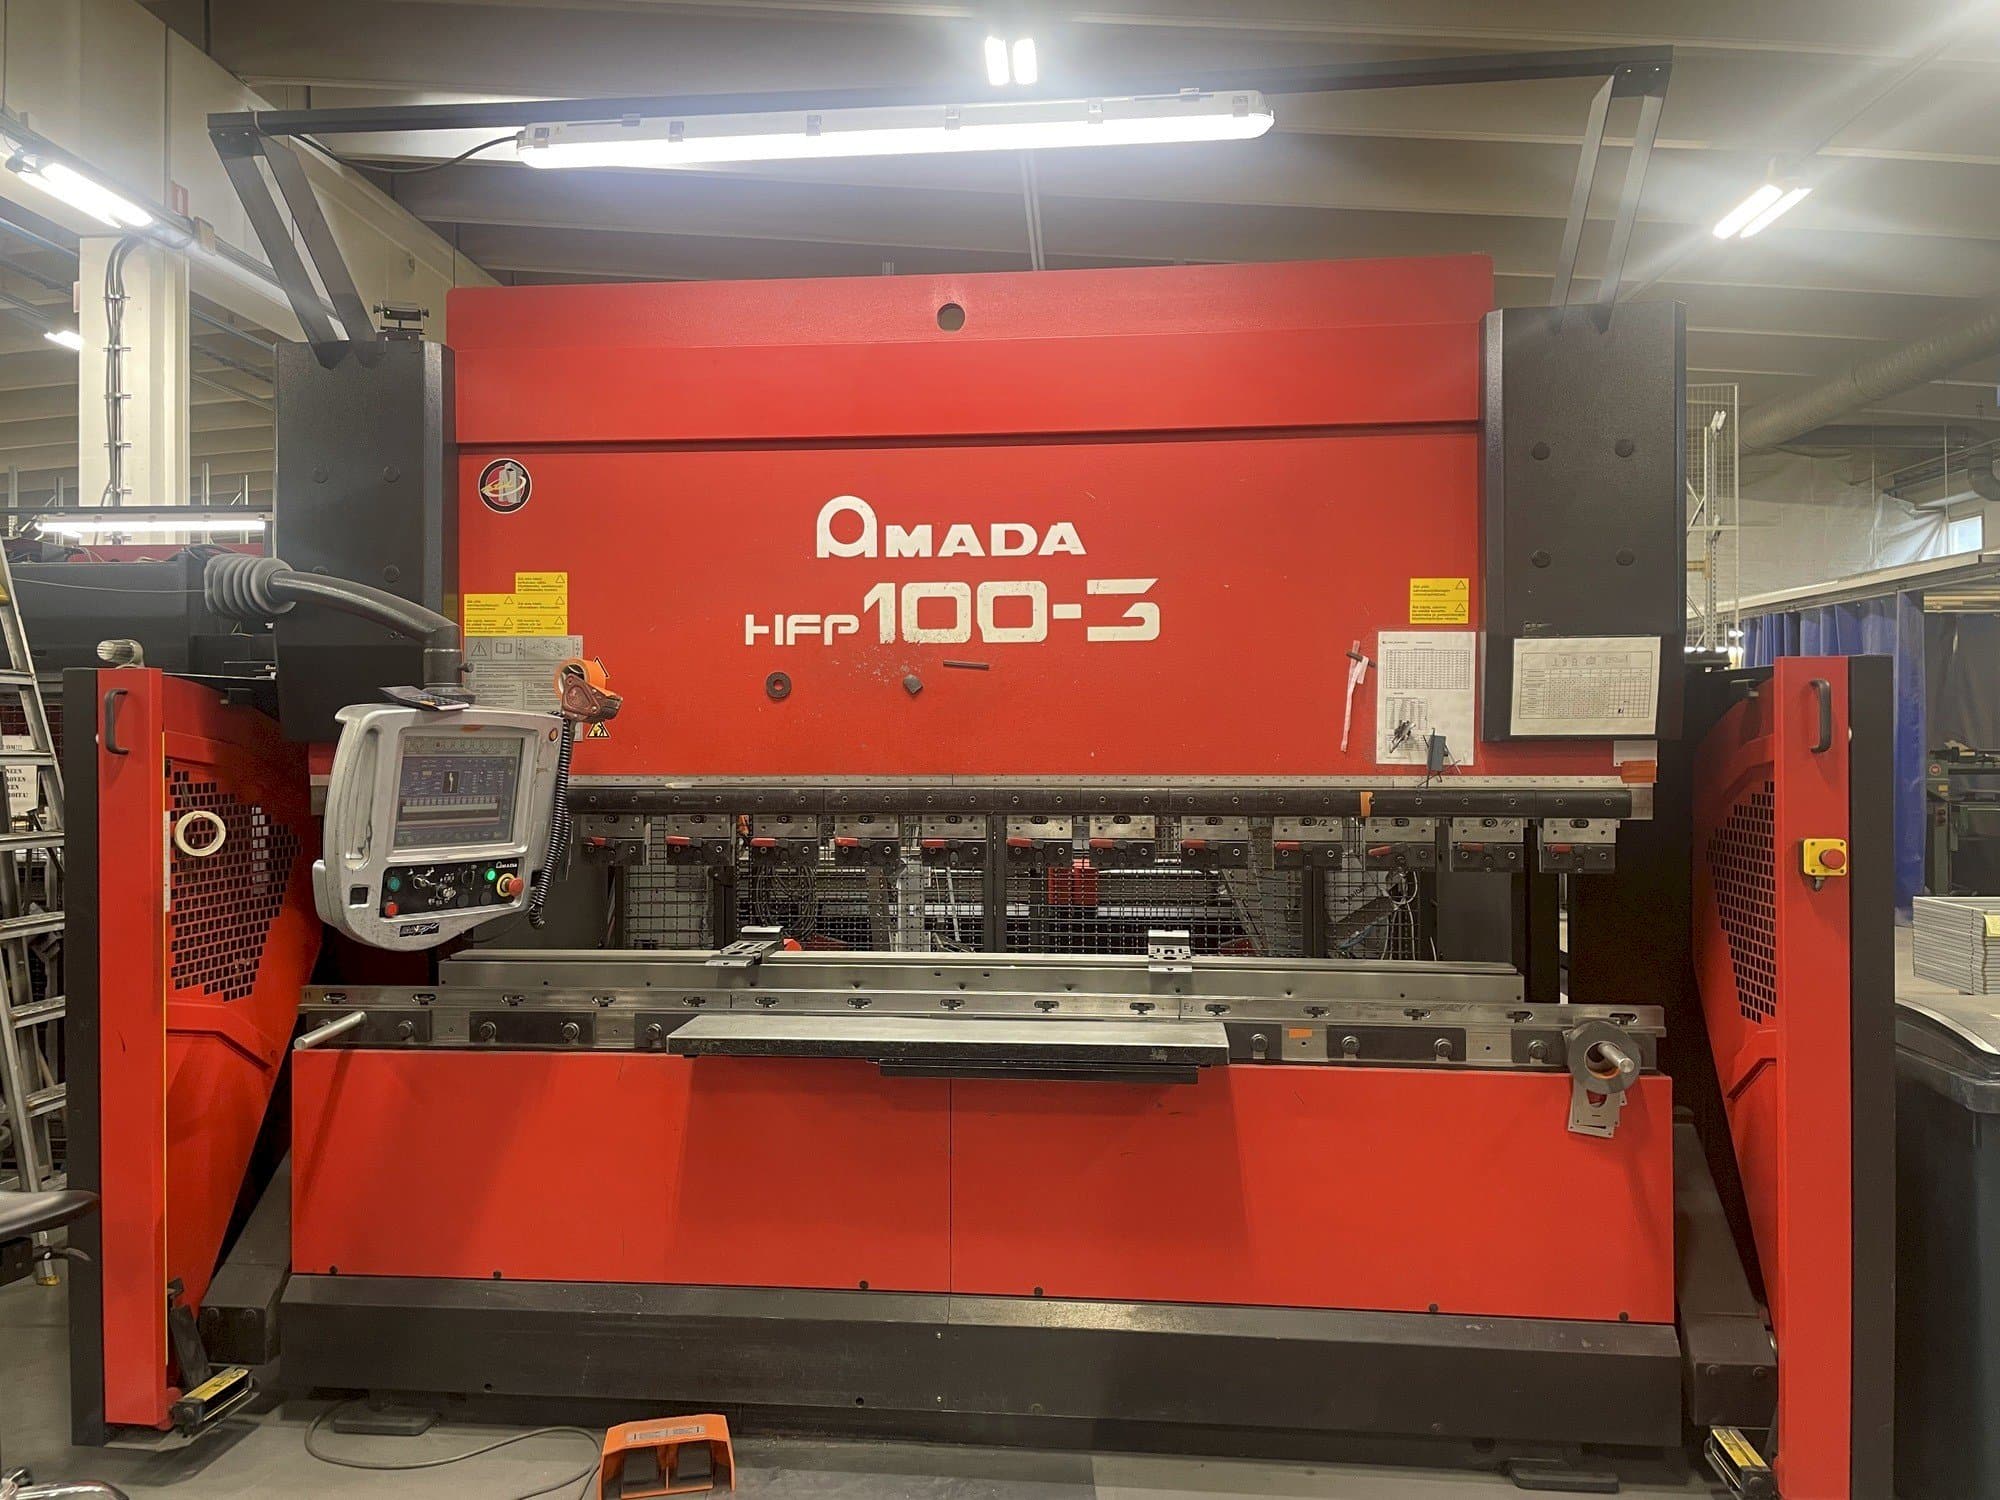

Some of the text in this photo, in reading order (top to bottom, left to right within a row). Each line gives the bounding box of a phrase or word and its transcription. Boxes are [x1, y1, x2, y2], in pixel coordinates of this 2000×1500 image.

[816, 495, 1087, 558] AMADA
[745, 578, 1160, 646] HFP 100-3
